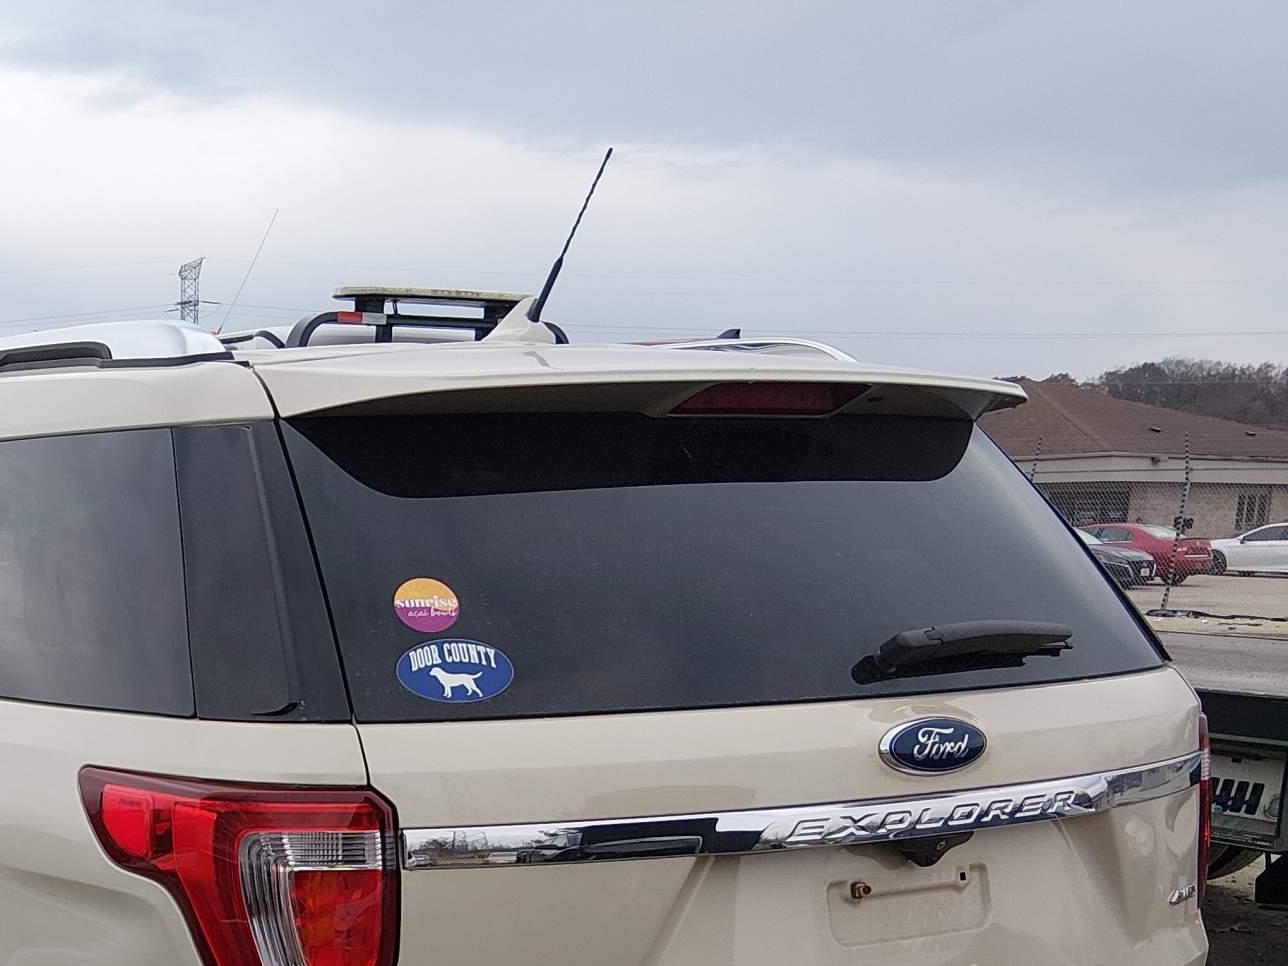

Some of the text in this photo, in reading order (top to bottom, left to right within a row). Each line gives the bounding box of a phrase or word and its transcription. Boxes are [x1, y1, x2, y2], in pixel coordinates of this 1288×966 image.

[396, 595, 457, 608] sunrise
[431, 607, 457, 617] bowls
[409, 643, 497, 672] DOOR COUNTY
[913, 727, 969, 760] Ford
[784, 789, 1088, 842] EXPLORER
